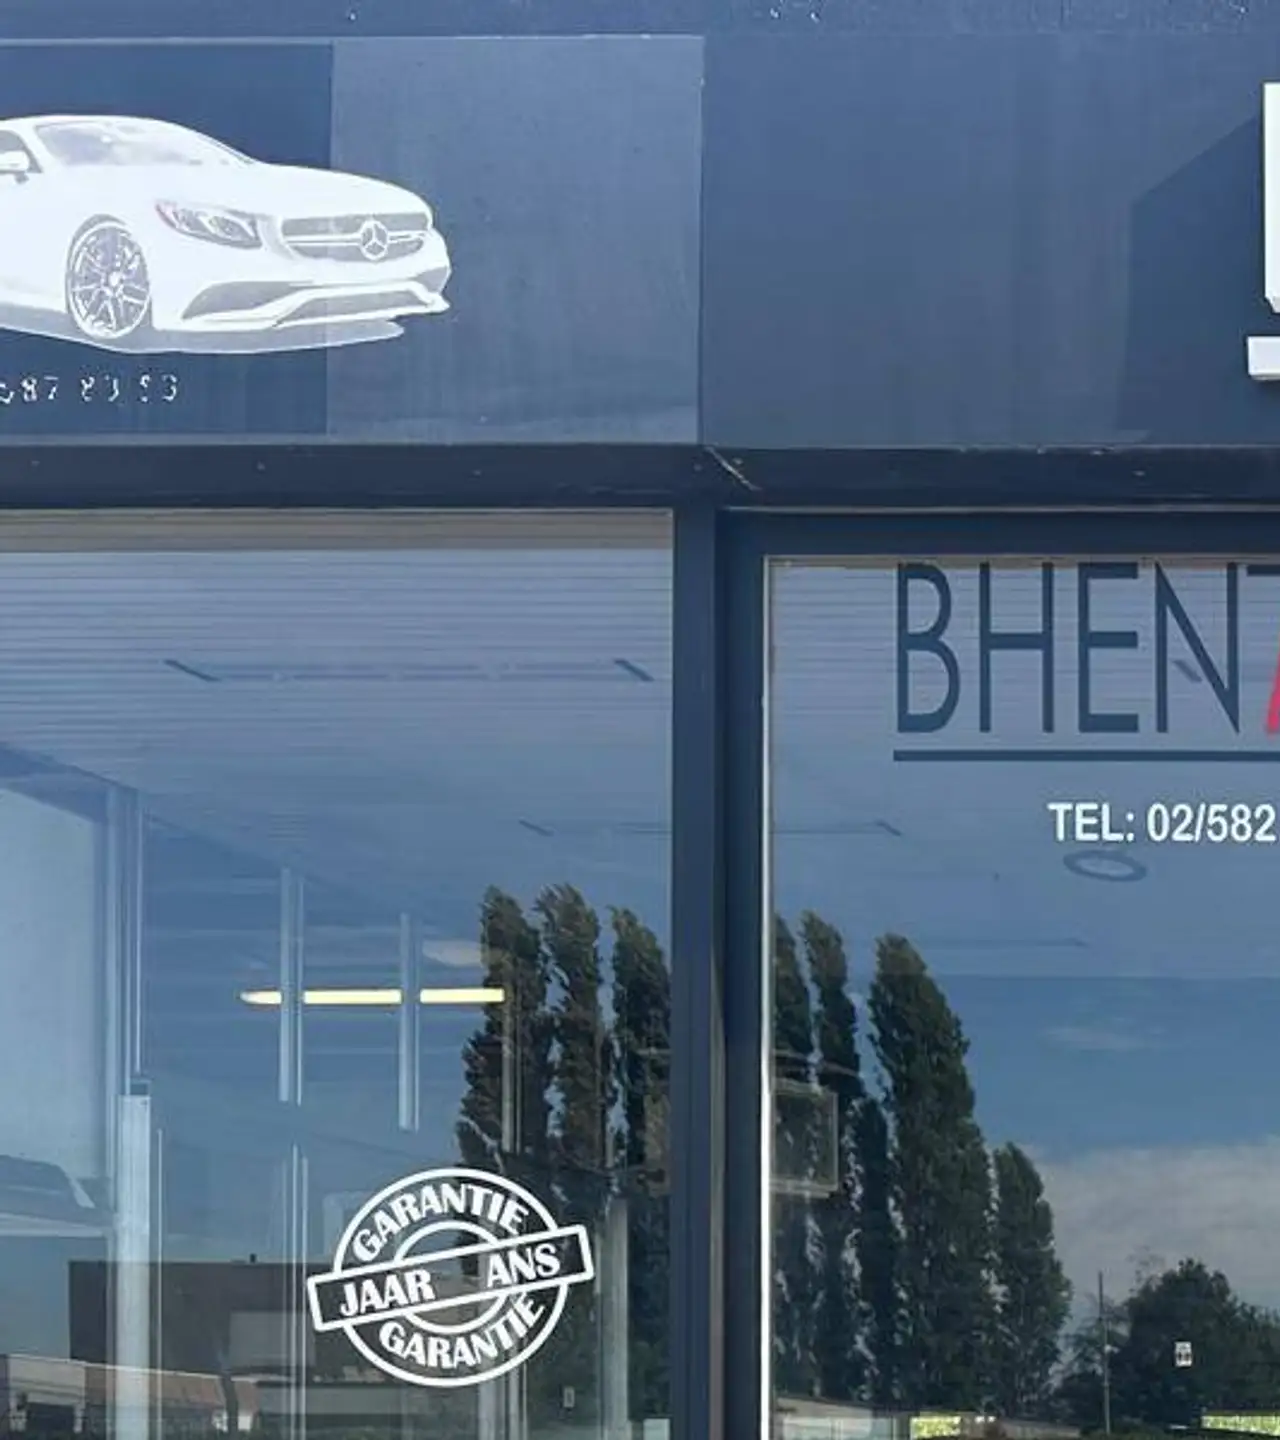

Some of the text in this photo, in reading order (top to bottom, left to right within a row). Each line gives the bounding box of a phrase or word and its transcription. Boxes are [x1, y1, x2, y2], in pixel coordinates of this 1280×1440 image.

[897, 562, 1240, 734] BHEN
[1048, 803, 1135, 842] TEL:
[352, 1183, 529, 1262] GARANTIE
[340, 1243, 562, 1317] JAAR ANS
[379, 1291, 546, 1370] GARANTIE
